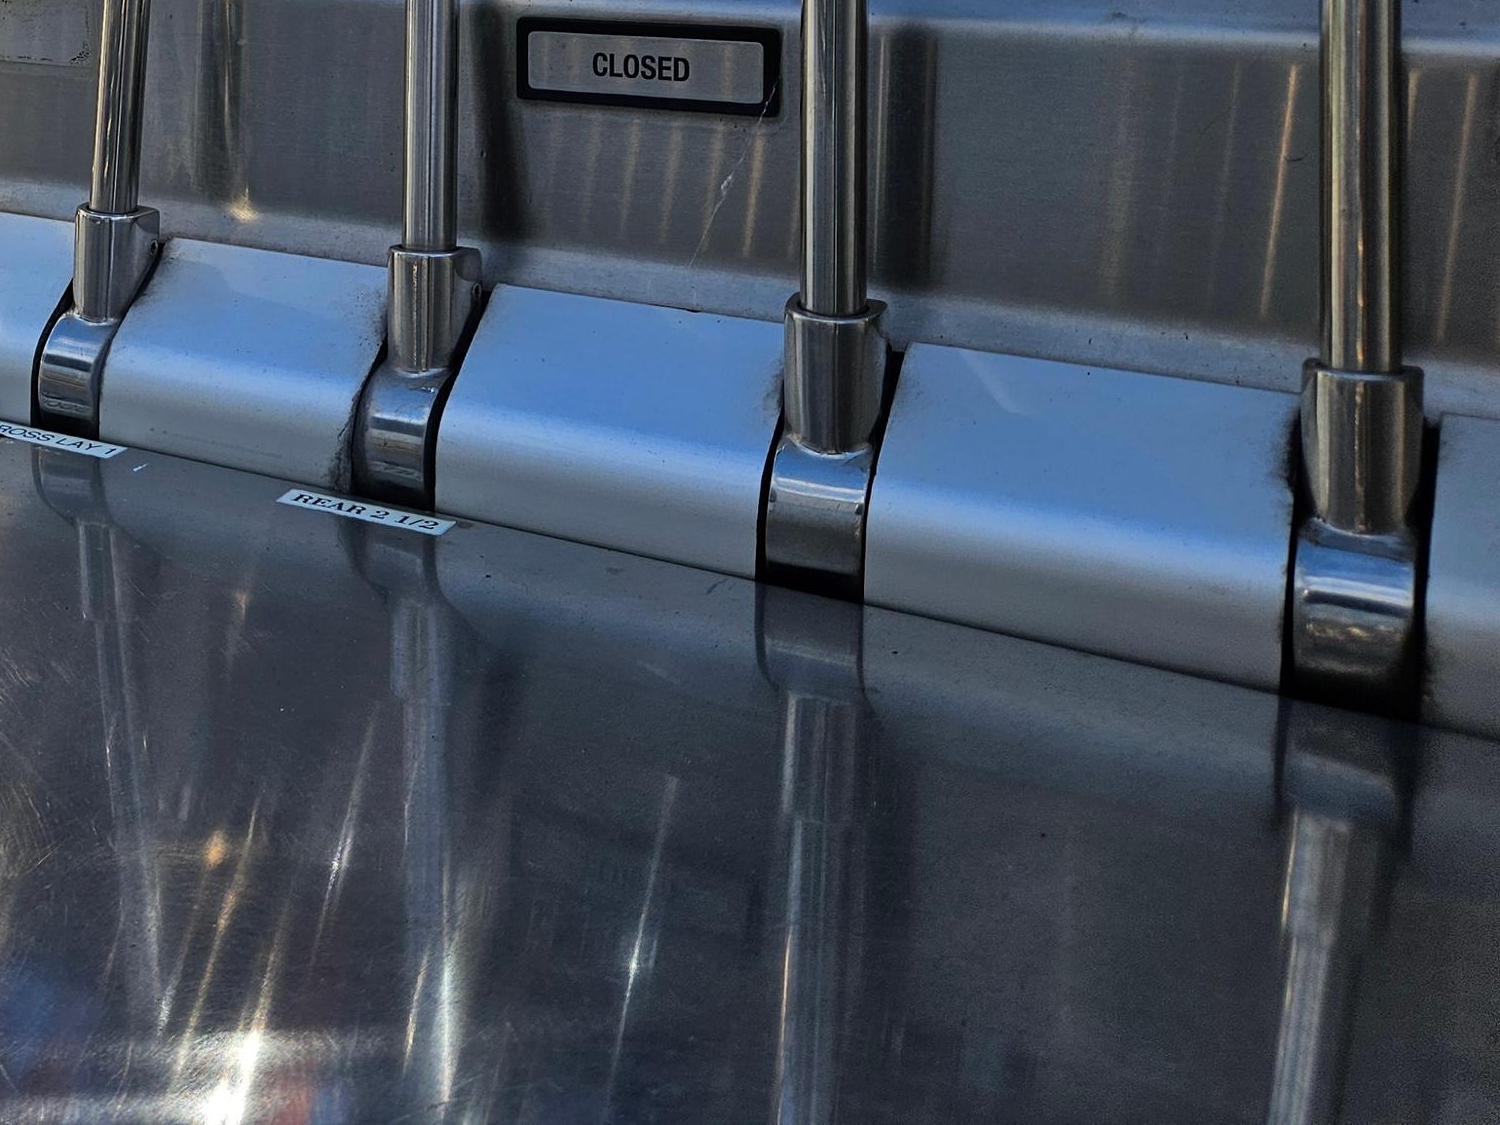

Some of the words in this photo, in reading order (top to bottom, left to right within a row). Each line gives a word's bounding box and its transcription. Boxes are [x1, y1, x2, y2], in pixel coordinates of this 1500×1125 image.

[592, 52, 690, 82] CLOSED
[56, 437, 102, 452] LAY
[292, 493, 366, 516] REAR
[370, 509, 390, 520] 2
[394, 515, 439, 531] 1/2
